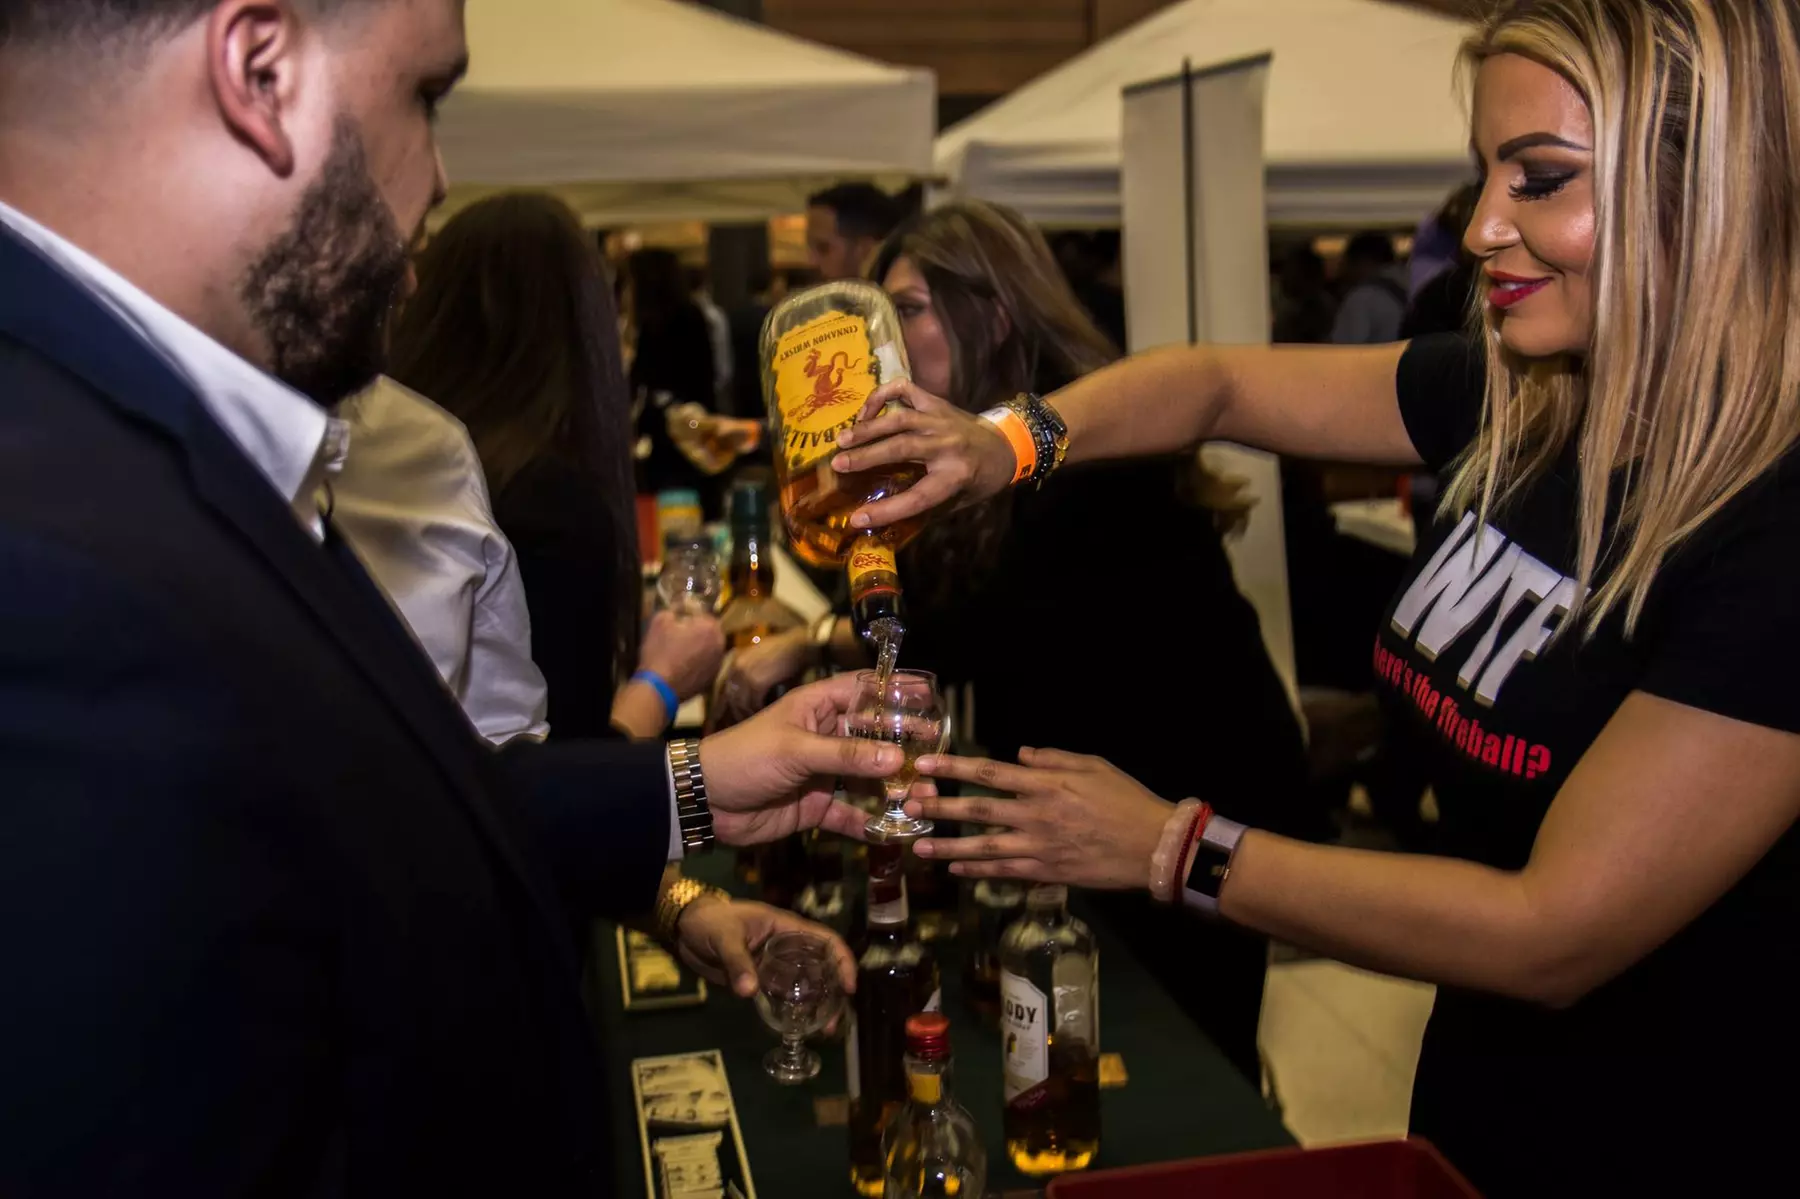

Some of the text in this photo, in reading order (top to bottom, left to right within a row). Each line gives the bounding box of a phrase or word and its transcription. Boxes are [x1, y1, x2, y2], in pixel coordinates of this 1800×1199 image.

[812, 324, 859, 346] CINNAMON
[779, 340, 811, 363] WHISKY
[1390, 510, 1592, 709] WTF
[1373, 632, 1414, 695] here's
[1412, 673, 1441, 720] the
[1006, 999, 1038, 1023] DDY
